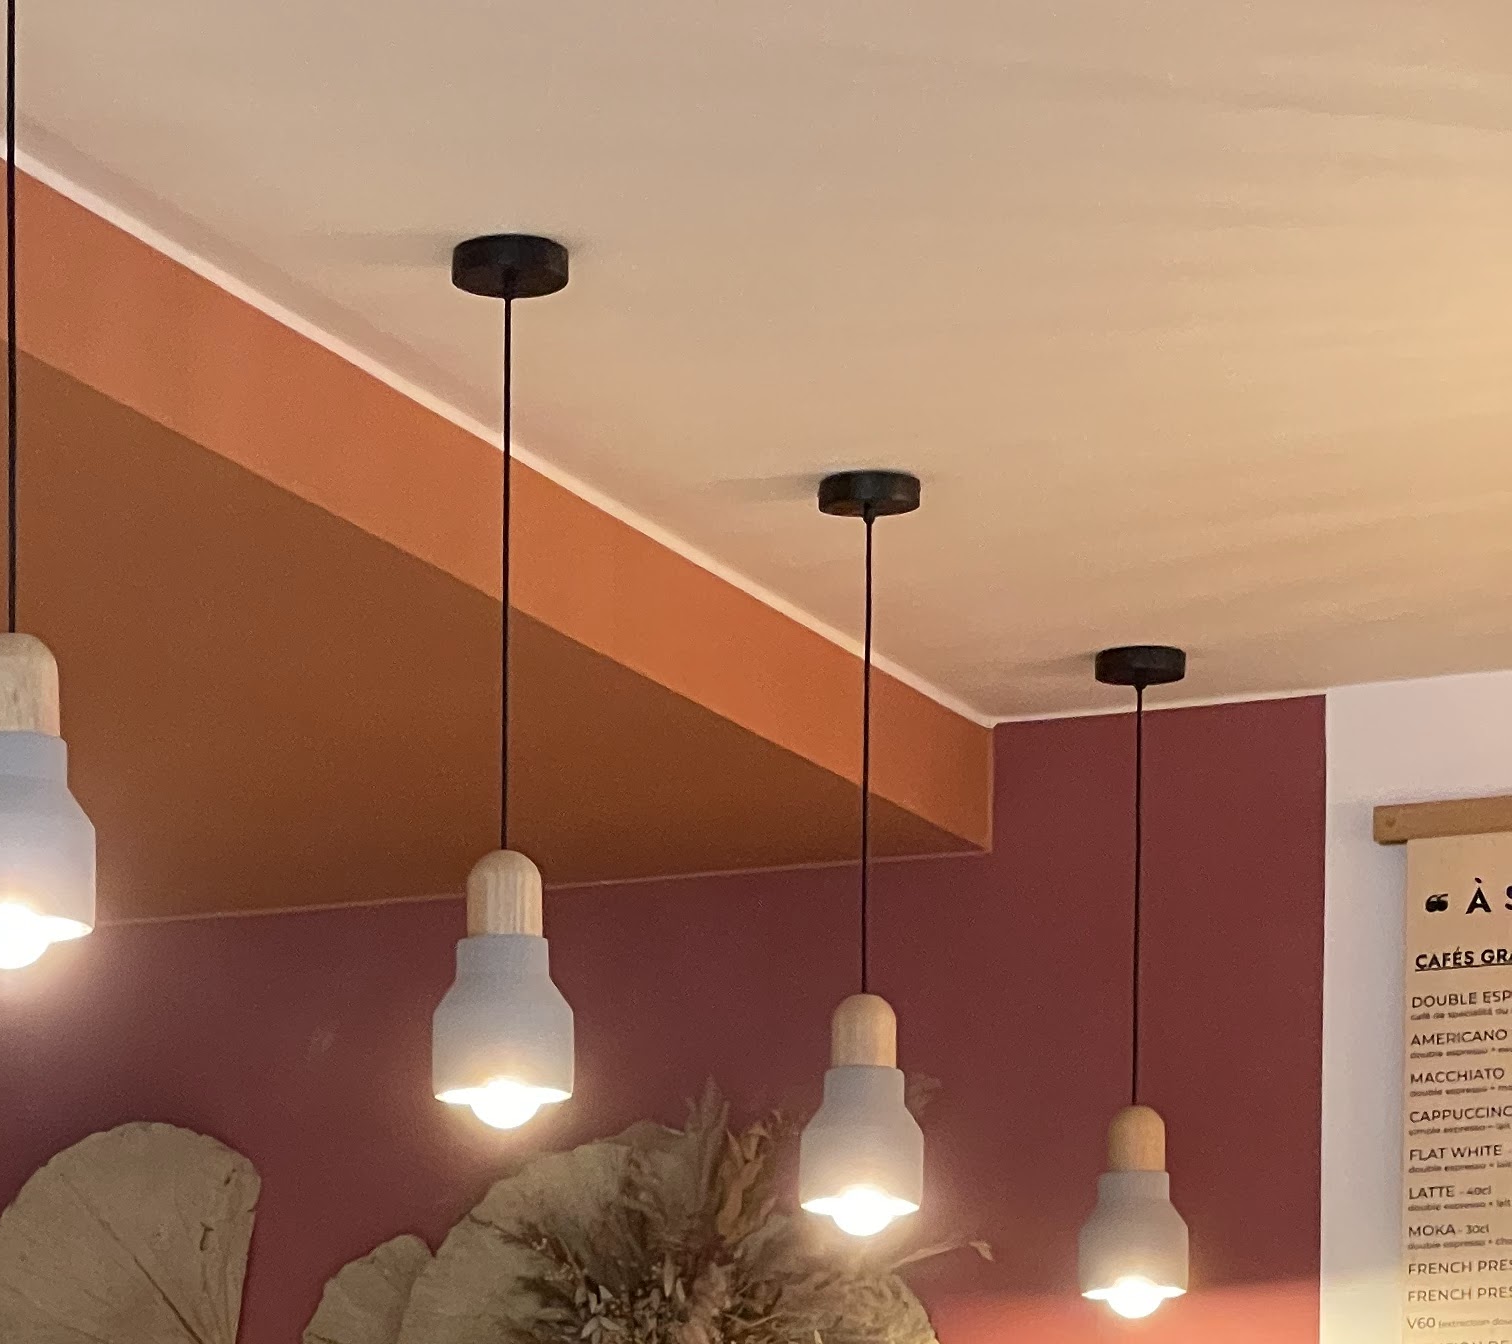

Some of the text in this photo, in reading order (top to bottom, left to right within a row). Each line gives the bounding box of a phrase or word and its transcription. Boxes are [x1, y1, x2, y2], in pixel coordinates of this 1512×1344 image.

[1415, 946, 1512, 970] CAFÉS GR
[1412, 991, 1477, 1009] DOUBLE
[1411, 1029, 1508, 1046] AMERICANO
[1410, 1067, 1505, 1084] MACCHIATO
[1409, 1144, 1503, 1162] FLAT WHITE
[1408, 1185, 1456, 1200] LATTE
[1408, 1224, 1456, 1238] MOKA
[1408, 1261, 1472, 1275] FRENCH
[1408, 1287, 1472, 1302] FRENCH
[1406, 1317, 1436, 1330] V60
